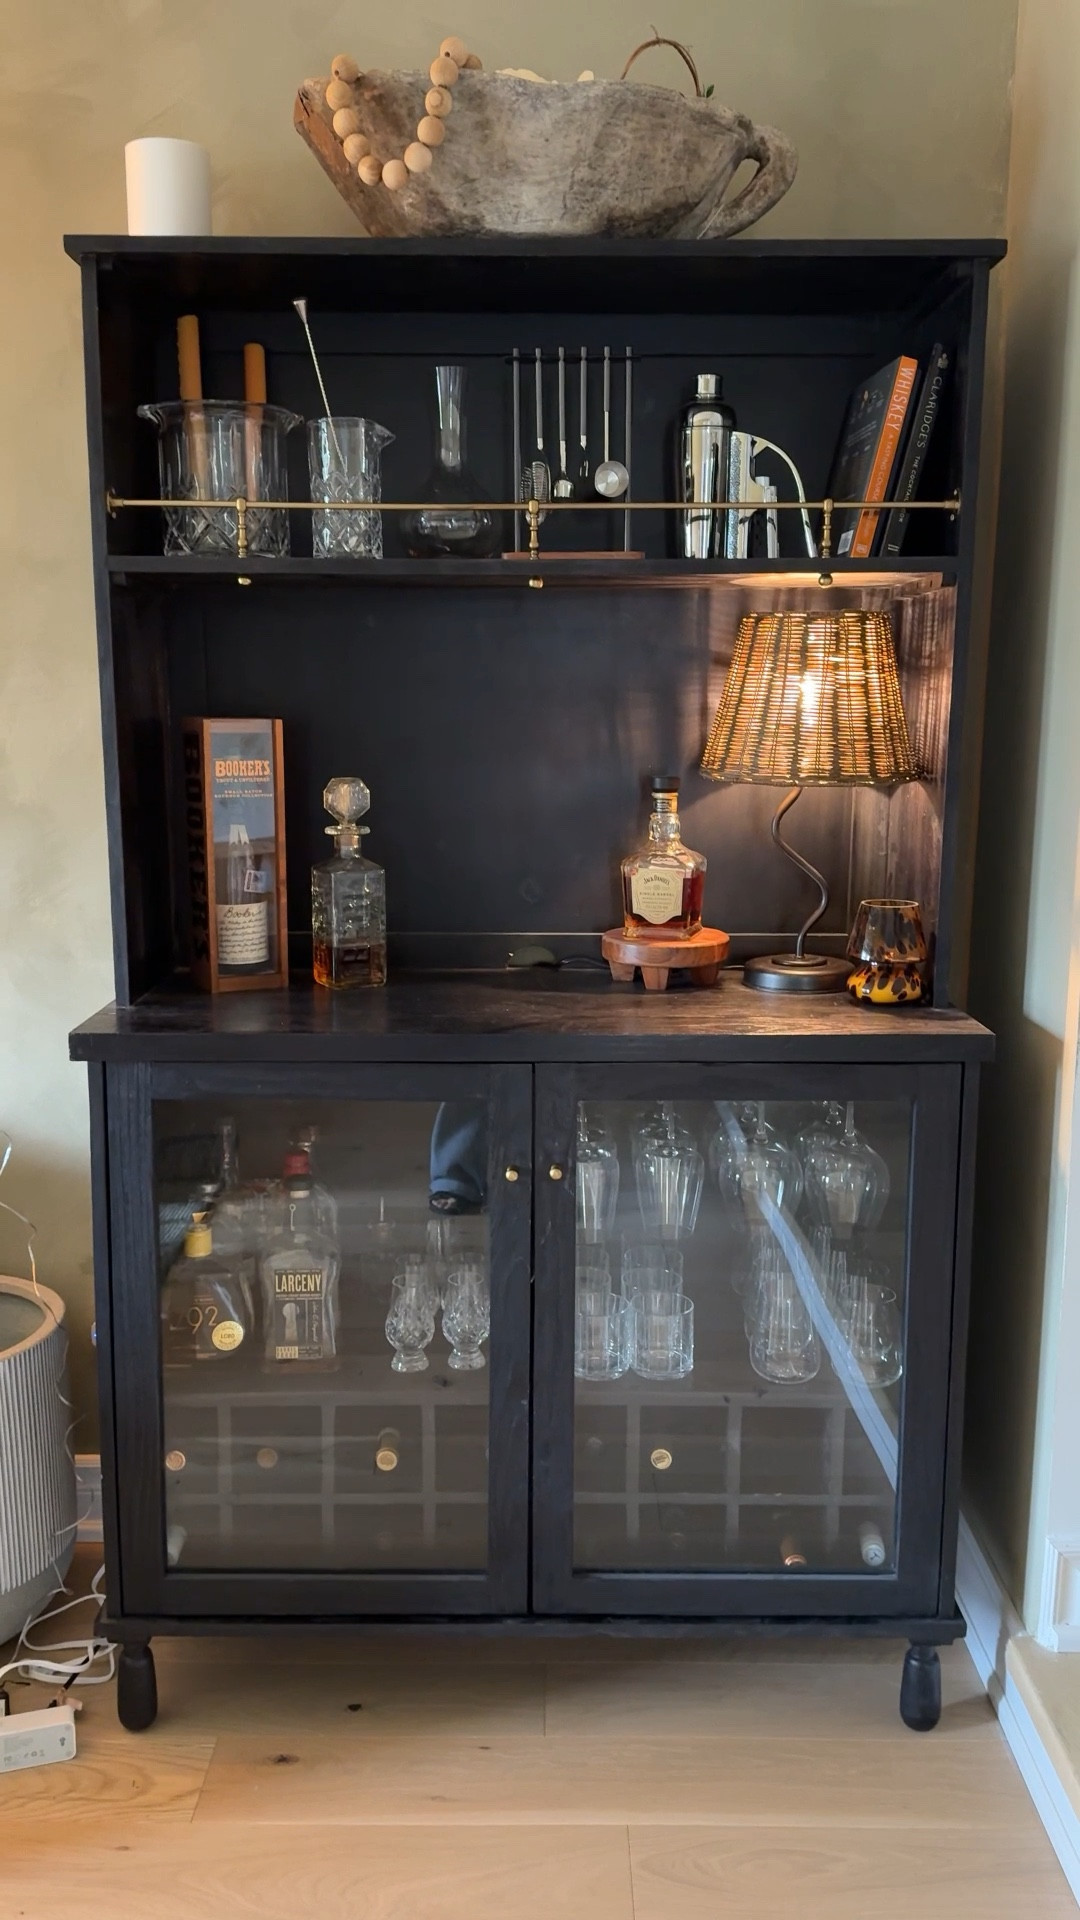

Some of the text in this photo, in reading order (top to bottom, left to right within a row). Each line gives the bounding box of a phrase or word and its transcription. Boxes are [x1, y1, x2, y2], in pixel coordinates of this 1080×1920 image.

[888, 366, 915, 431] WHISKEY
[912, 455, 921, 468] THE
[275, 1274, 321, 1292] LARCENY
